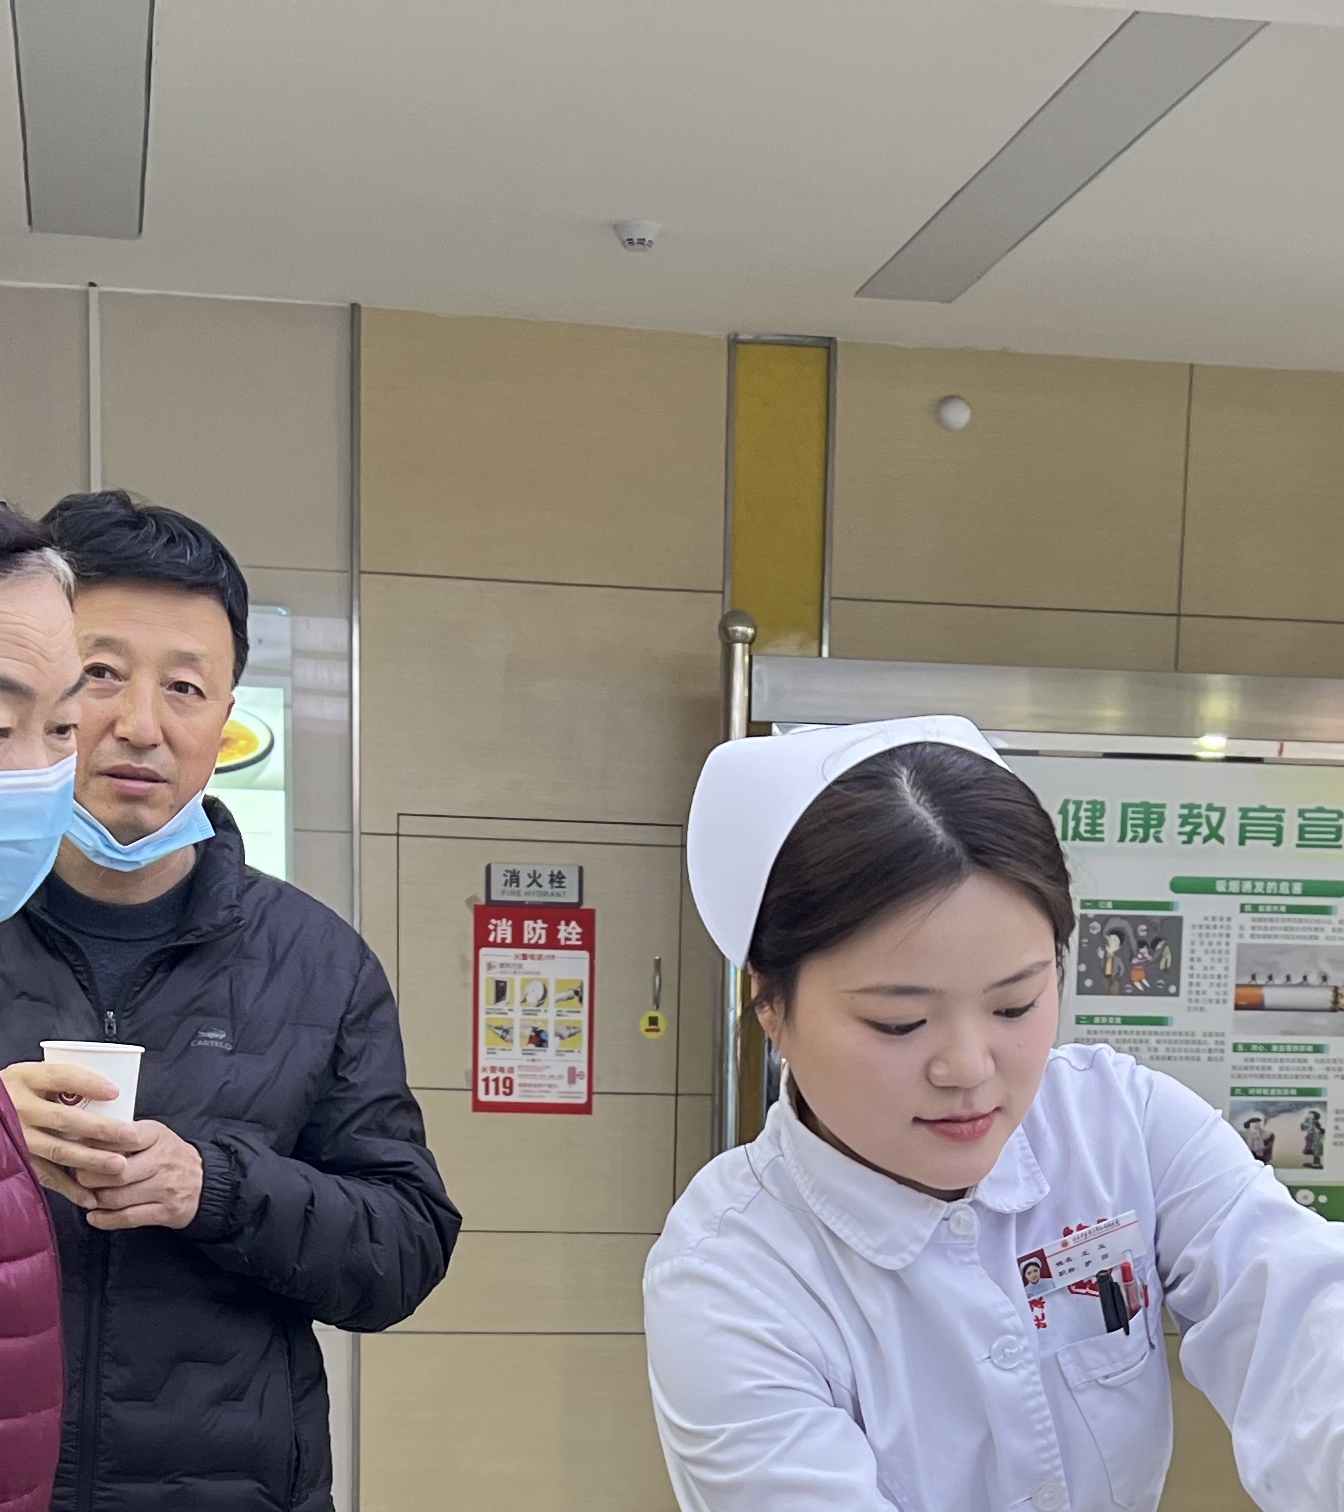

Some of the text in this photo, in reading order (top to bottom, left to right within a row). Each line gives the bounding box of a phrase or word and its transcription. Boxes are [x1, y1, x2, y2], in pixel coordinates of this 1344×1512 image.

[503, 868, 567, 889] 消火栓
[501, 889, 567, 898] FIRE HYDRANT
[487, 918, 583, 945] 消防栓
[190, 1039, 233, 1051] CARTELO
[481, 1075, 514, 1097] 119
